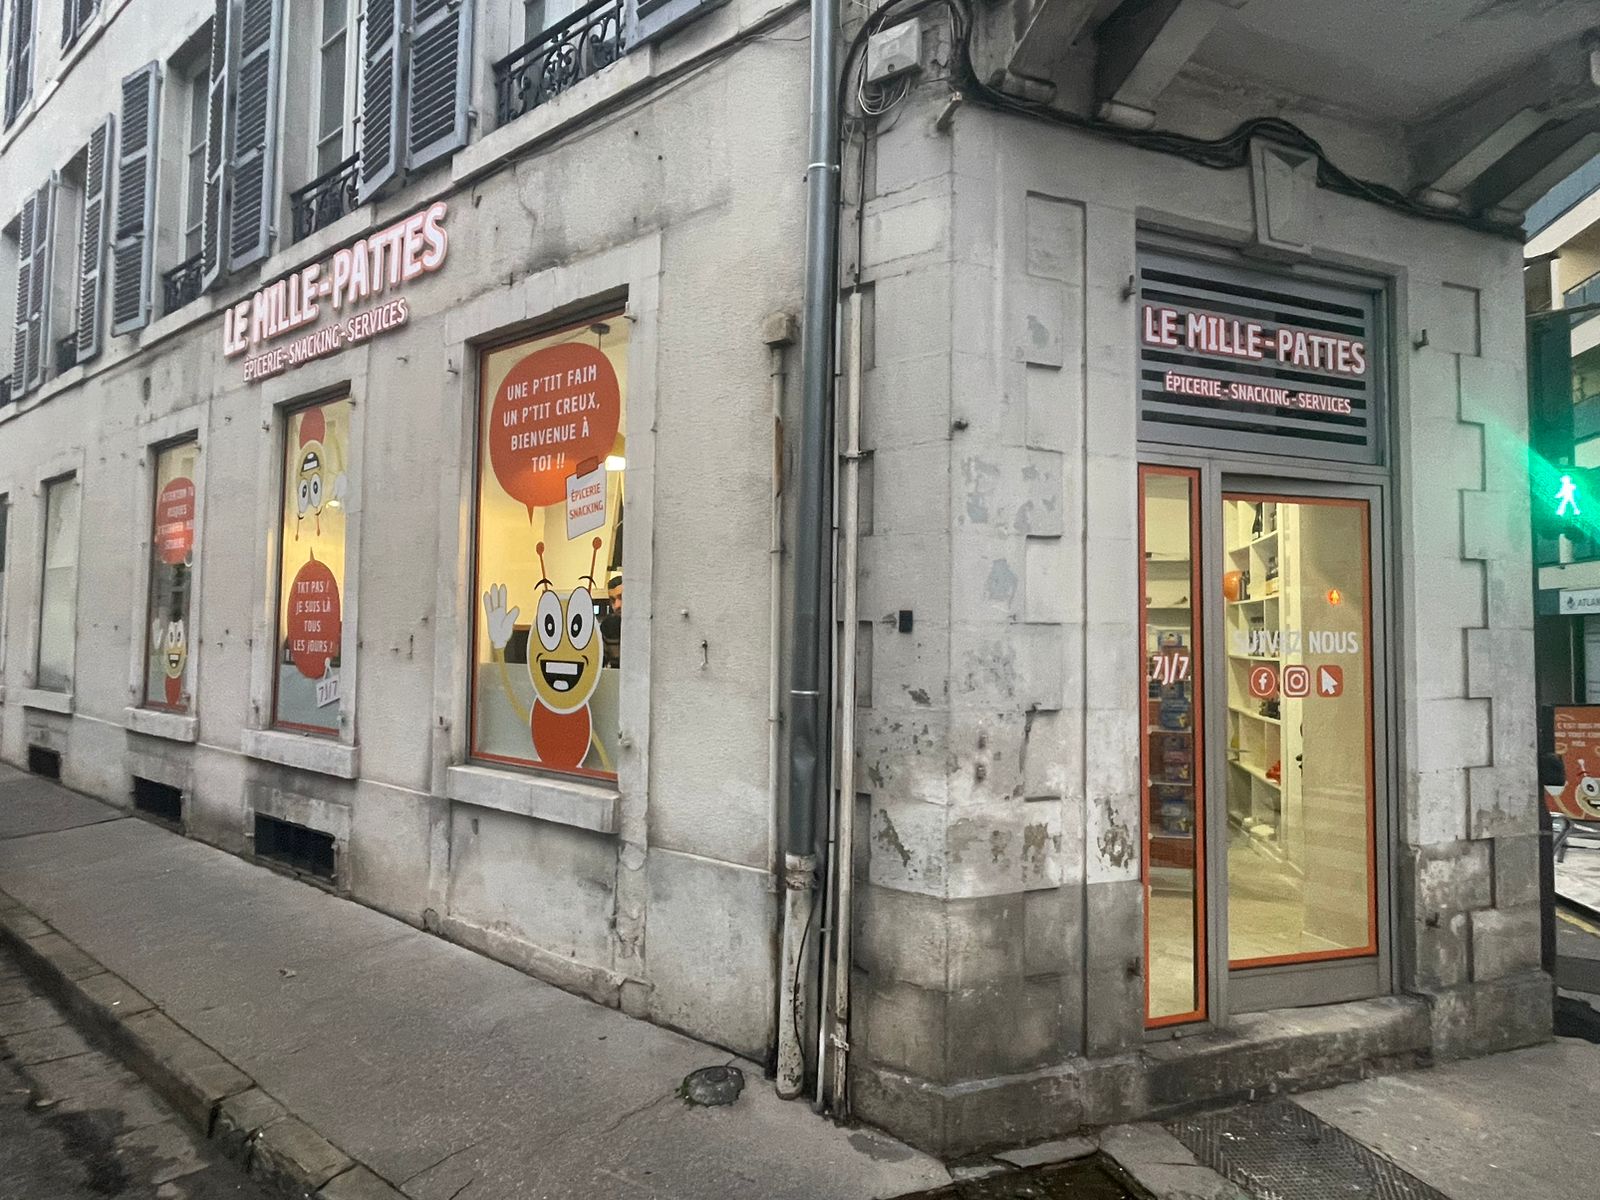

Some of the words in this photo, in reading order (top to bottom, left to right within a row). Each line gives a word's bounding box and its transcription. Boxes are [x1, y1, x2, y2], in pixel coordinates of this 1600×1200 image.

[223, 301, 249, 356] LE
[252, 201, 447, 343] MILLE-PATTES
[243, 348, 283, 382] ÉPICERIE
[288, 325, 341, 364] SNACKING
[346, 298, 407, 342] SERVICES
[1144, 306, 1178, 346] LE
[1187, 313, 1365, 374] MILLE-PATTES
[507, 382, 528, 401] UNE
[532, 373, 563, 395] P'TIT
[567, 364, 597, 387] FAIM
[1166, 370, 1221, 397] ÉPICERIE
[1231, 383, 1290, 406] SNACKING
[1298, 392, 1351, 414] SERVICES
[503, 411, 518, 427] UN
[522, 402, 551, 424] P'TIT
[556, 392, 600, 416] CREUX,
[511, 423, 576, 451] BIENVENUE
[581, 416, 590, 438] À
[532, 455, 552, 473] TOI
[571, 482, 601, 502] ÉPICERIE
[569, 500, 604, 520] SNACKING
[297, 581, 309, 594] TKT
[311, 580, 324, 594] PAS
[304, 600, 320, 613] SUIS
[322, 597, 331, 613] LÀ
[304, 620, 321, 632] TOUS
[293, 640, 305, 652] LES
[1309, 630, 1359, 654] NOUS
